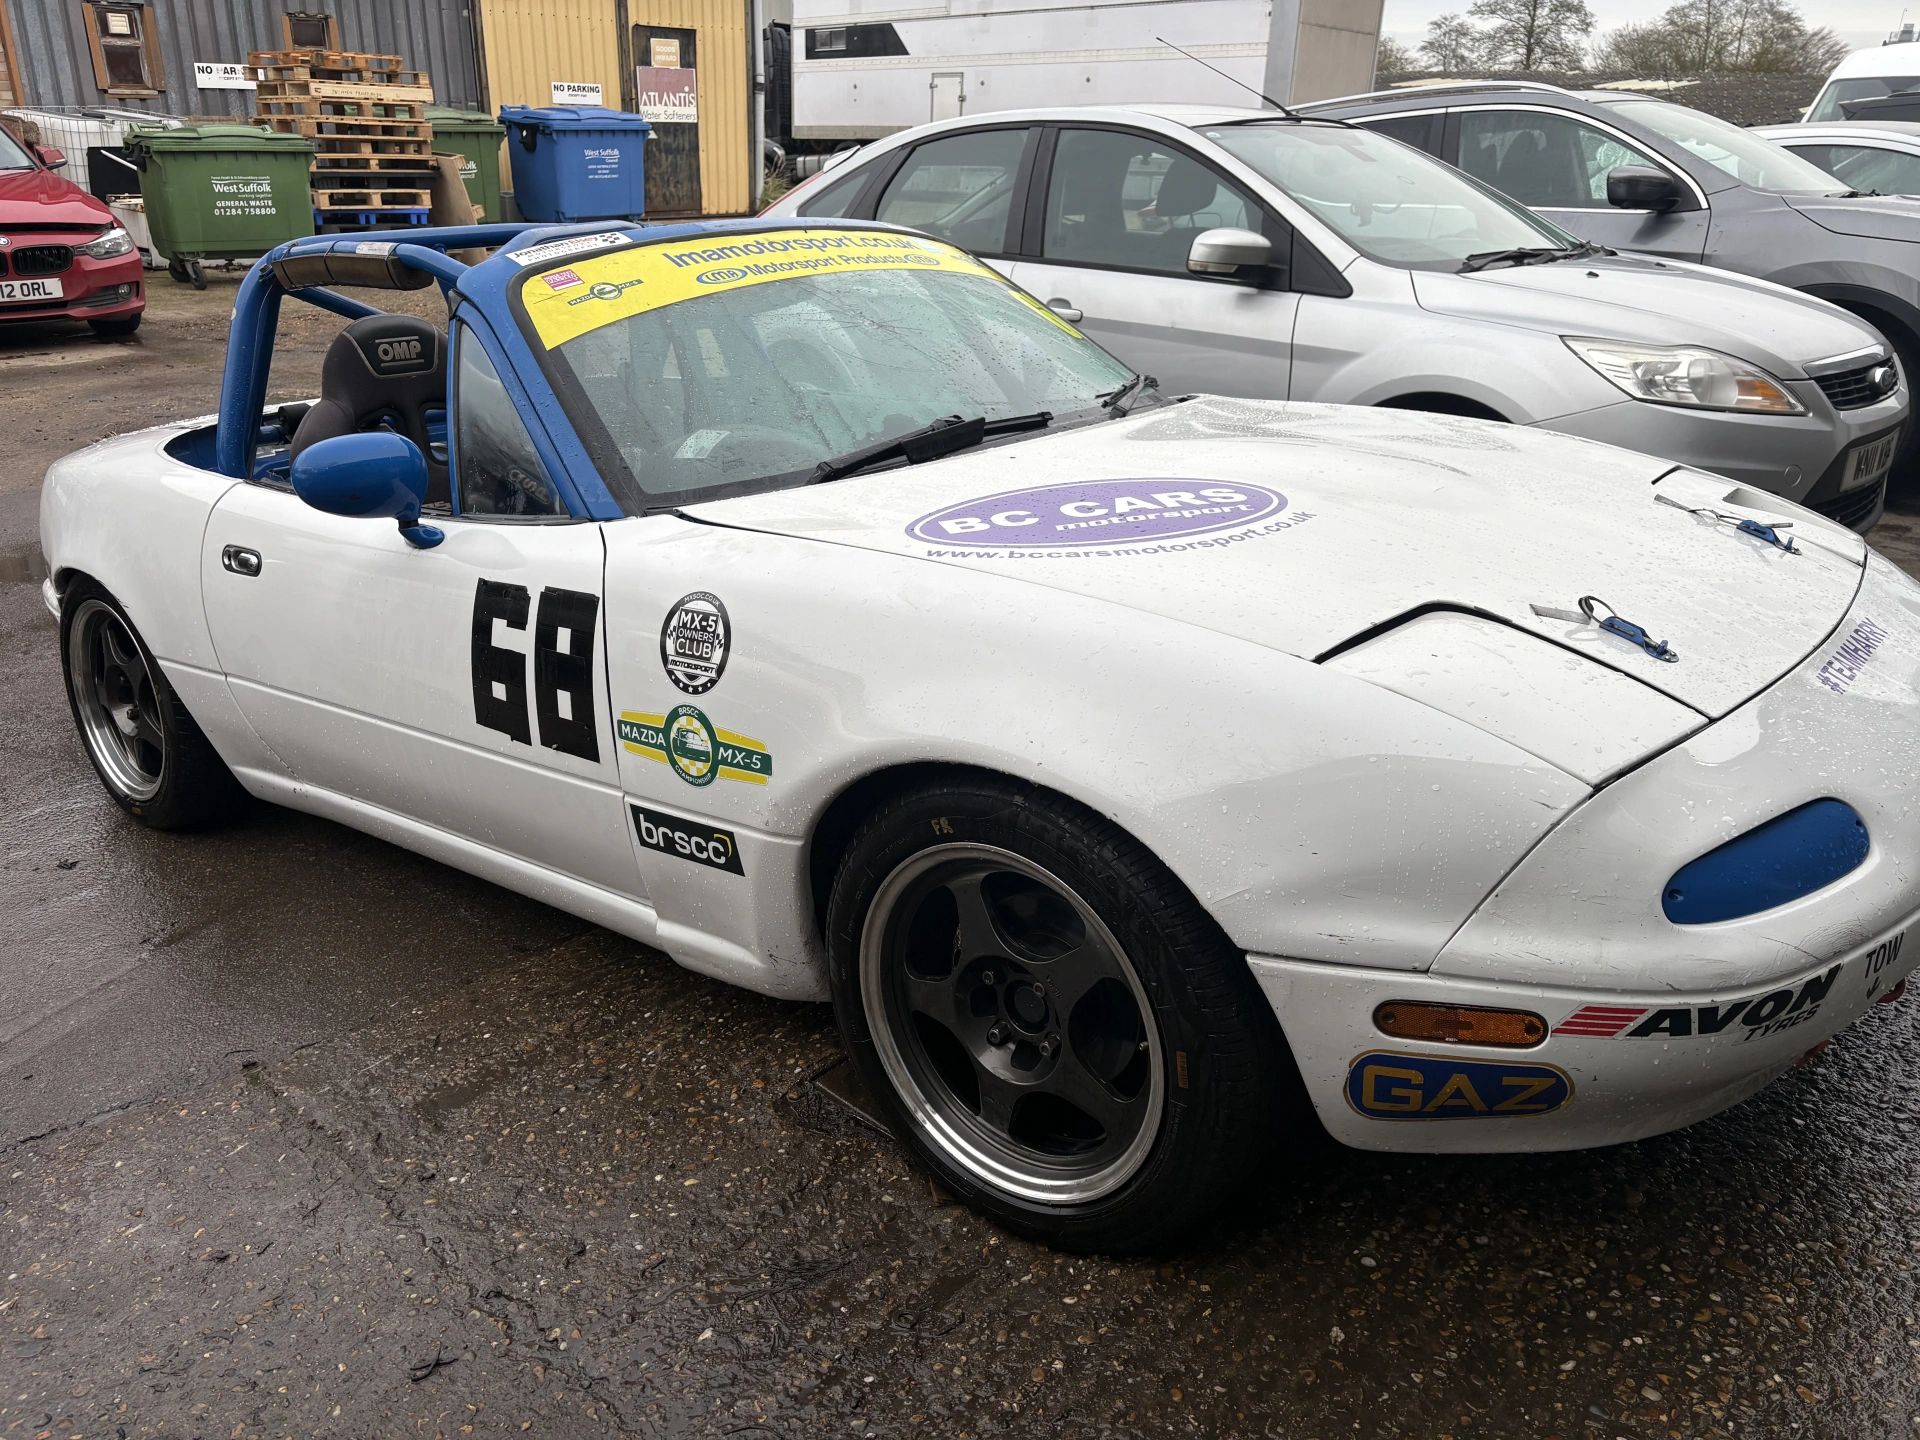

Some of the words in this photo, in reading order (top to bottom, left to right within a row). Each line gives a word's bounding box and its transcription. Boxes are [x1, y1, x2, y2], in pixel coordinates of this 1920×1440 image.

[197, 65, 213, 75] NO
[553, 84, 565, 92] NO
[567, 85, 600, 93] PARKING
[640, 110, 661, 120] Water
[664, 110, 696, 120] Softeners
[212, 184, 238, 193] West
[239, 184, 272, 193] Suffolk
[513, 241, 569, 258] Jonathan
[744, 254, 838, 276] Motorsport
[838, 254, 906, 265] Products
[20, 281, 53, 297] ORL
[570, 294, 595, 305] MAZDA
[619, 280, 638, 289] MX-5
[378, 341, 421, 361] OMP
[938, 510, 1039, 534] BC
[1059, 488, 1248, 518] CARS
[1055, 504, 1254, 531] motorsport
[926, 510, 1317, 559] www.bccarsmotorsport.co.uk
[680, 611, 717, 632] MX-5
[678, 628, 714, 642] OWNERS
[676, 638, 712, 658] CLUB
[1816, 617, 1888, 695] #TEAMHARRY
[472, 578, 600, 764] 68
[669, 659, 714, 674] MOTORSPORT
[678, 707, 699, 718] BRSCC
[621, 724, 666, 746] MAZDA
[717, 747, 762, 769] MX-5
[675, 765, 712, 784] CHAMPIONSHIP
[639, 813, 726, 864] brscc
[1865, 931, 1905, 978] TOW
[1624, 963, 1843, 1037] AVON
[1743, 1004, 1821, 1041] TYRES
[1362, 1065, 1557, 1112] GAZ
